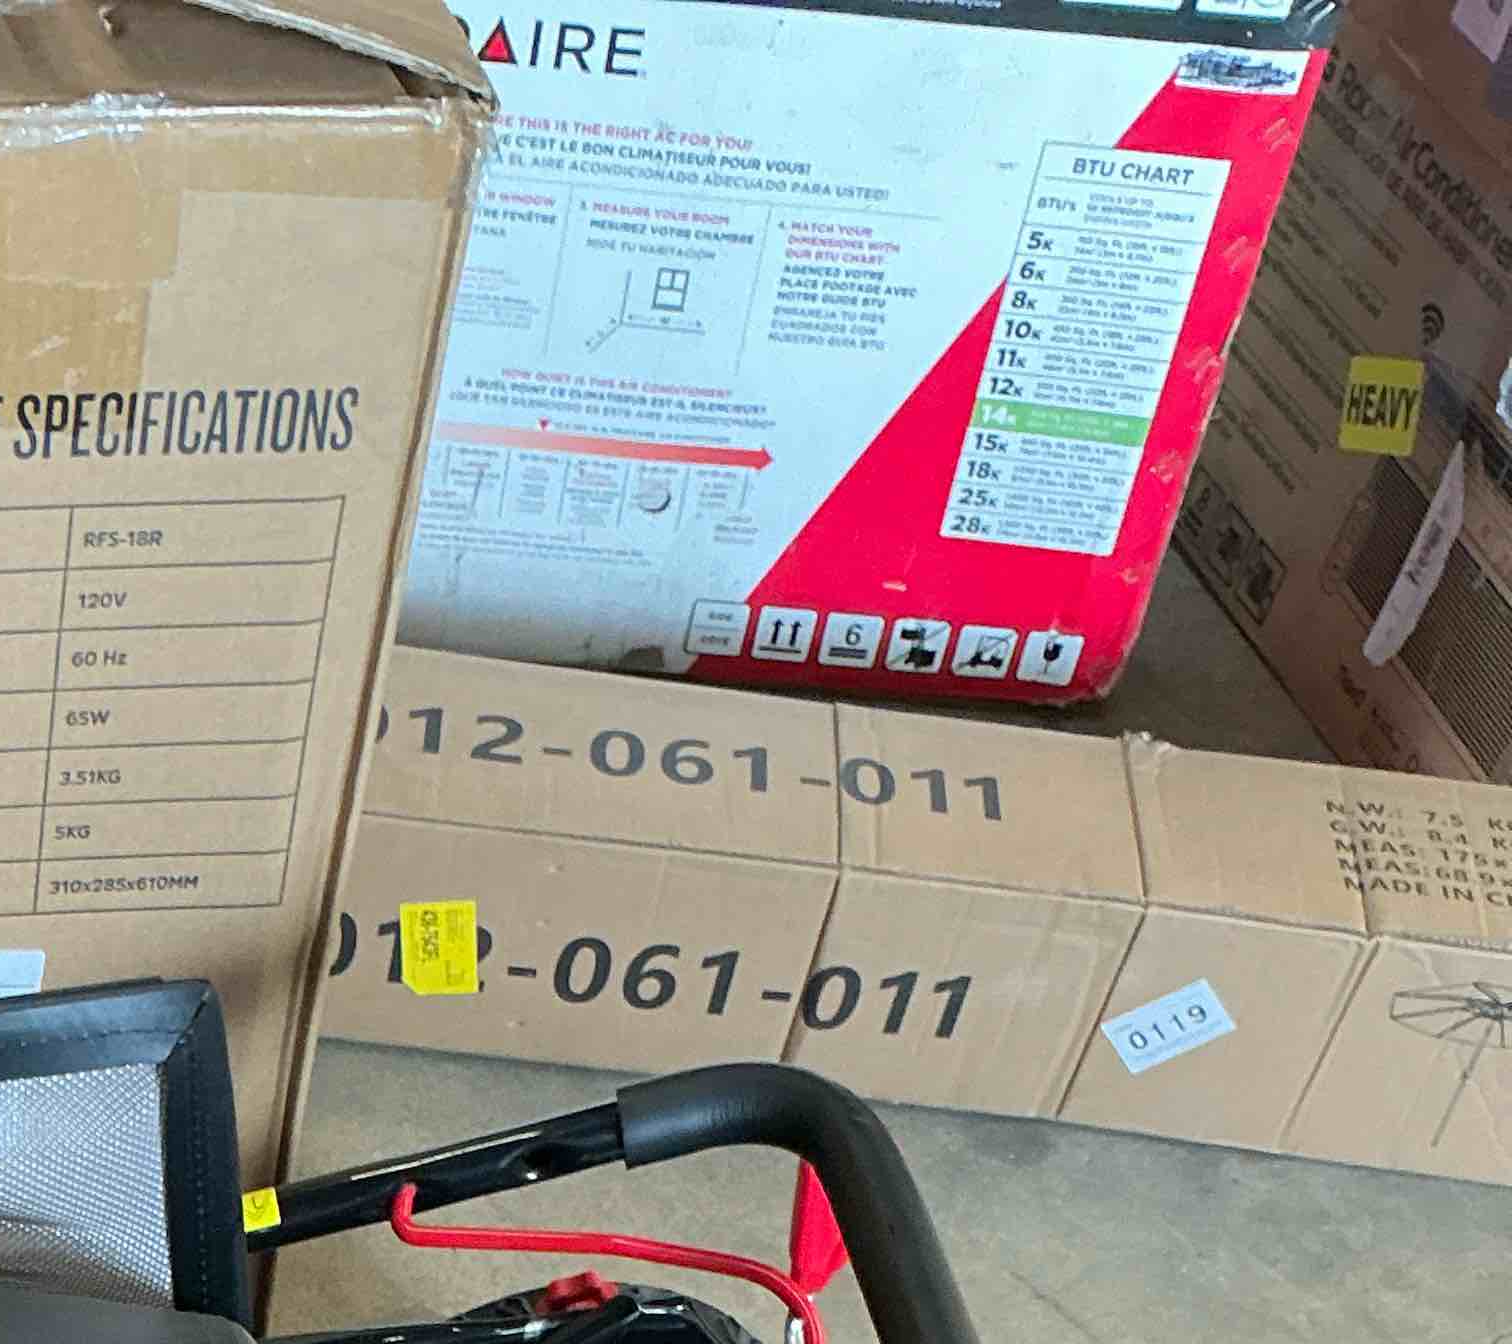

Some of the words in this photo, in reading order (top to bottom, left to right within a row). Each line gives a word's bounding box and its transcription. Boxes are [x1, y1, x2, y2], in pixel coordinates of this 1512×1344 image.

[455, 15, 646, 77] AIRE
[519, 116, 543, 131] THIS
[574, 120, 601, 136] THE
[605, 124, 650, 141] RIGHT
[654, 128, 677, 145] AC
[680, 132, 711, 147] FOR
[582, 142, 615, 156] BON
[719, 155, 761, 171] POUR
[1071, 157, 1115, 178] BTU
[1120, 162, 1195, 186] CHART
[791, 181, 832, 196] PARA
[1346, 382, 1419, 431] HEAVY
[13, 387, 360, 459] SPECIFICATIONS
[83, 530, 163, 549] RFS-18R
[77, 591, 128, 609] 120V
[844, 623, 864, 646] 6
[71, 650, 98, 668] 60
[102, 650, 128, 667] Hz
[65, 710, 110, 727] 65W
[375, 704, 1003, 821] 12-061-011
[58, 769, 122, 786] 3.51KG
[55, 824, 91, 841] 5KG
[1342, 875, 1430, 897] MADE
[1441, 884, 1475, 903] IN
[329, 911, 973, 1039] 1-061-011
[1129, 1004, 1208, 1050] 0119
